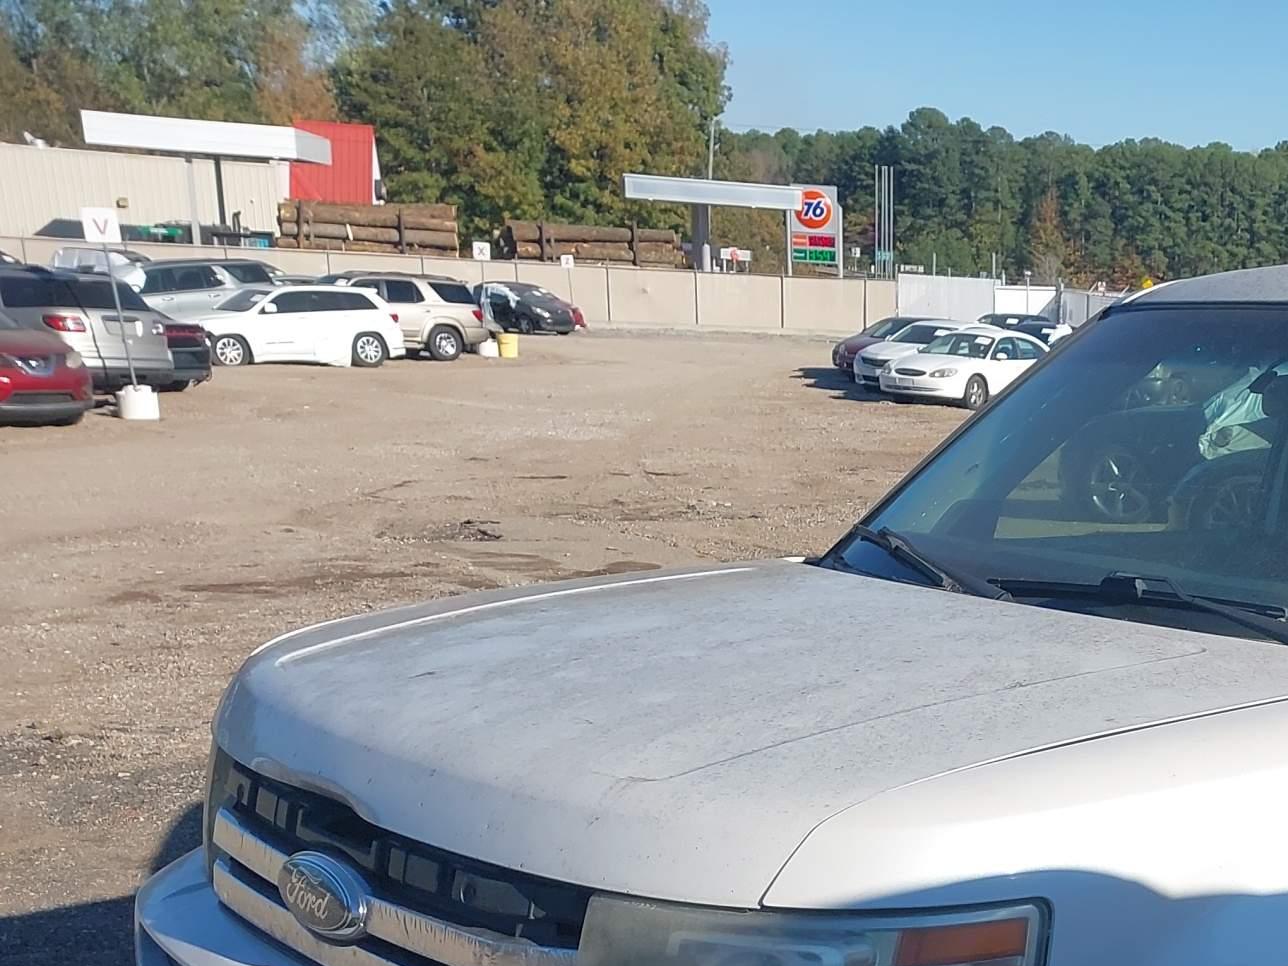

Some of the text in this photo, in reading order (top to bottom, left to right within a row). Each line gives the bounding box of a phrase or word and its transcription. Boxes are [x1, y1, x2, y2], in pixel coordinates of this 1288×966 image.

[803, 200, 825, 218] 76
[91, 217, 109, 236] V
[286, 864, 330, 920] Ford
